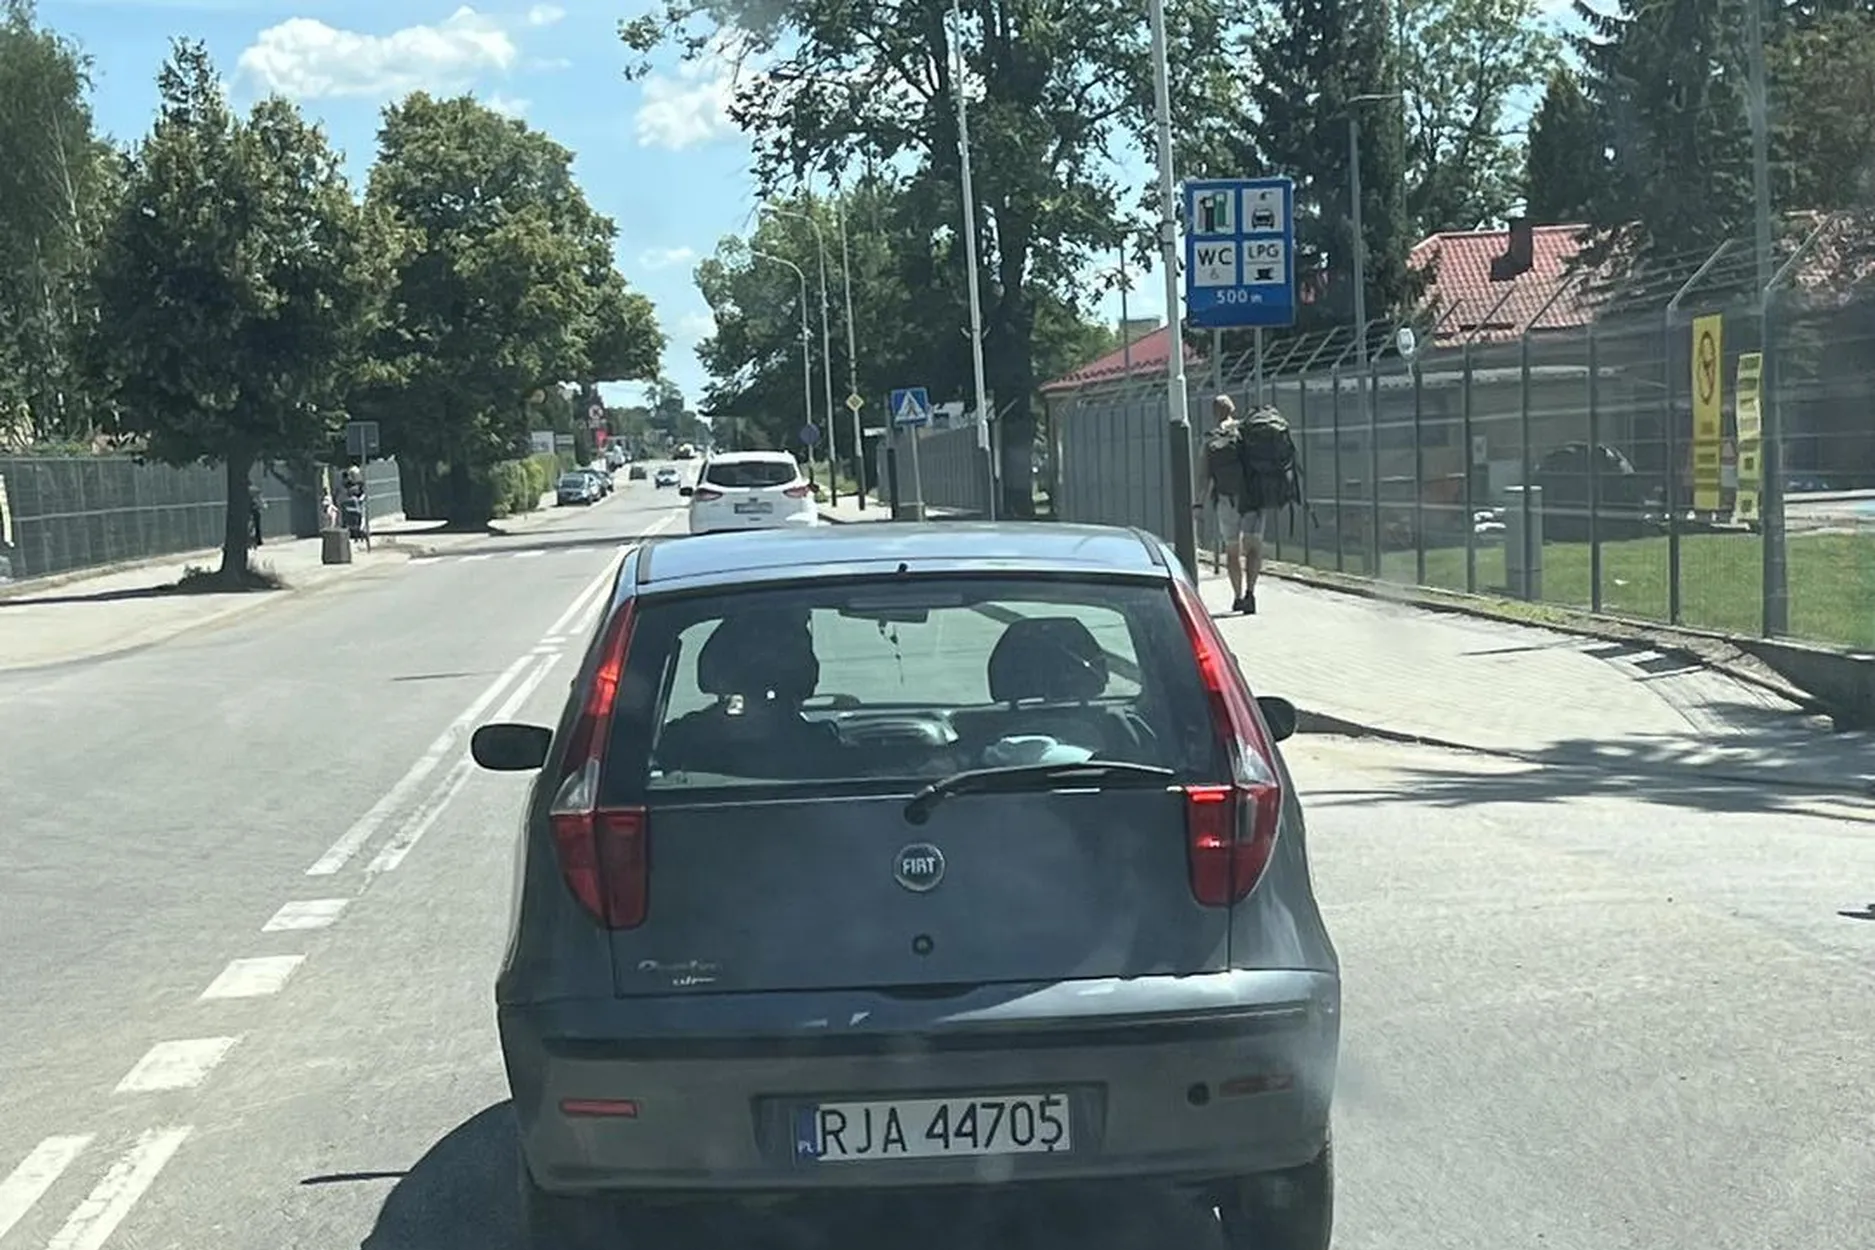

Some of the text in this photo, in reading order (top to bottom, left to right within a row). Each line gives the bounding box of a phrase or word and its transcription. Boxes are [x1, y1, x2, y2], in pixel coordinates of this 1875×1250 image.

[1198, 248, 1233, 266] WC
[1249, 244, 1279, 259] LPG
[1217, 289, 1248, 304] 500
[902, 857, 935, 875] FIAT
[821, 1100, 1064, 1155] RJA 44705
